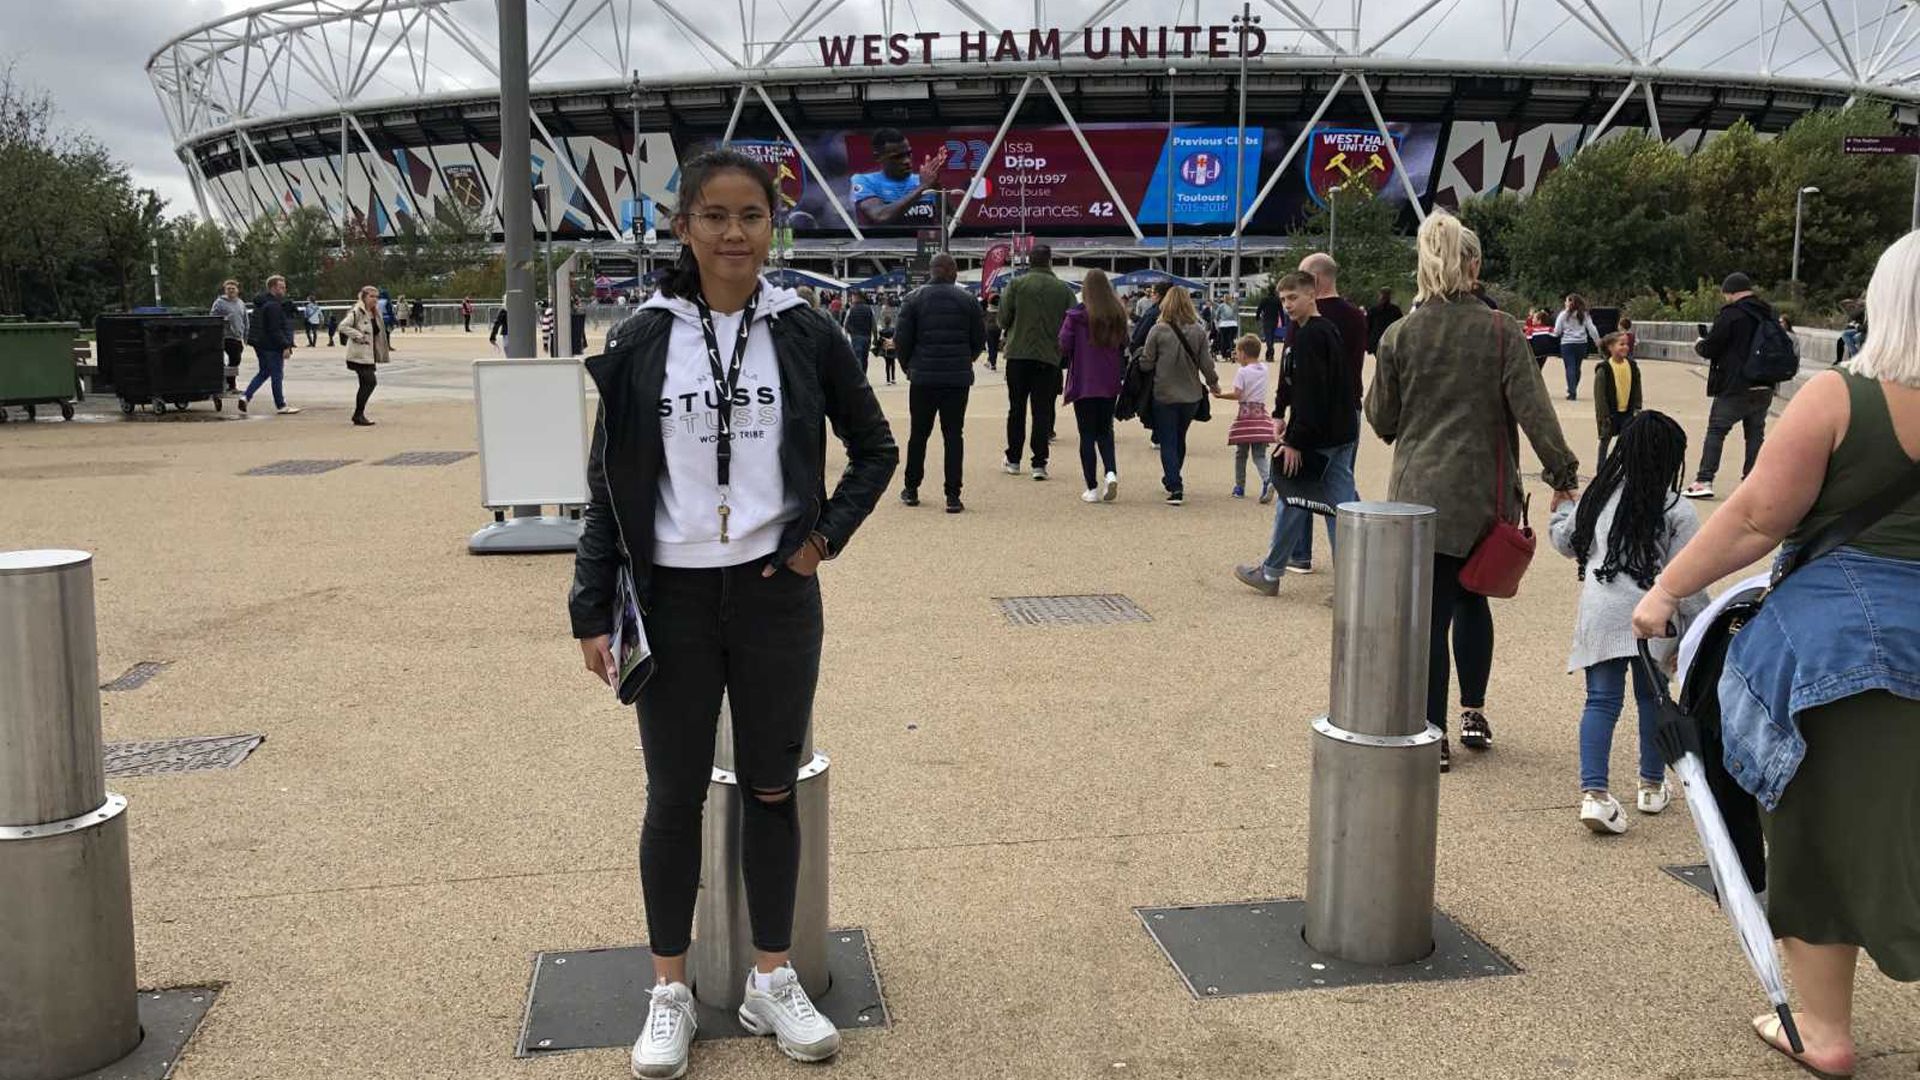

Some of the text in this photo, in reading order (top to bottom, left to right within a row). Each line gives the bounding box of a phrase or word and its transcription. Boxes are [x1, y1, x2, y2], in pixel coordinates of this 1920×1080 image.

[818, 24, 1266, 67] WEST HAM UNITED
[1172, 135, 1259, 146] Previous Clbs
[1323, 133, 1362, 144] WEST
[1003, 140, 1034, 153] Issa
[1337, 143, 1380, 152] UNITED
[1004, 155, 1047, 171] Diop
[998, 174, 1067, 186] 09/01/1997
[1000, 187, 1050, 197] Tououse
[1177, 193, 1228, 202] Toulouse
[904, 204, 934, 218] way
[977, 202, 1114, 219] Appearances: 42
[1174, 202, 1229, 212] 2015-2018
[699, 430, 765, 443] WOD TRIBE
